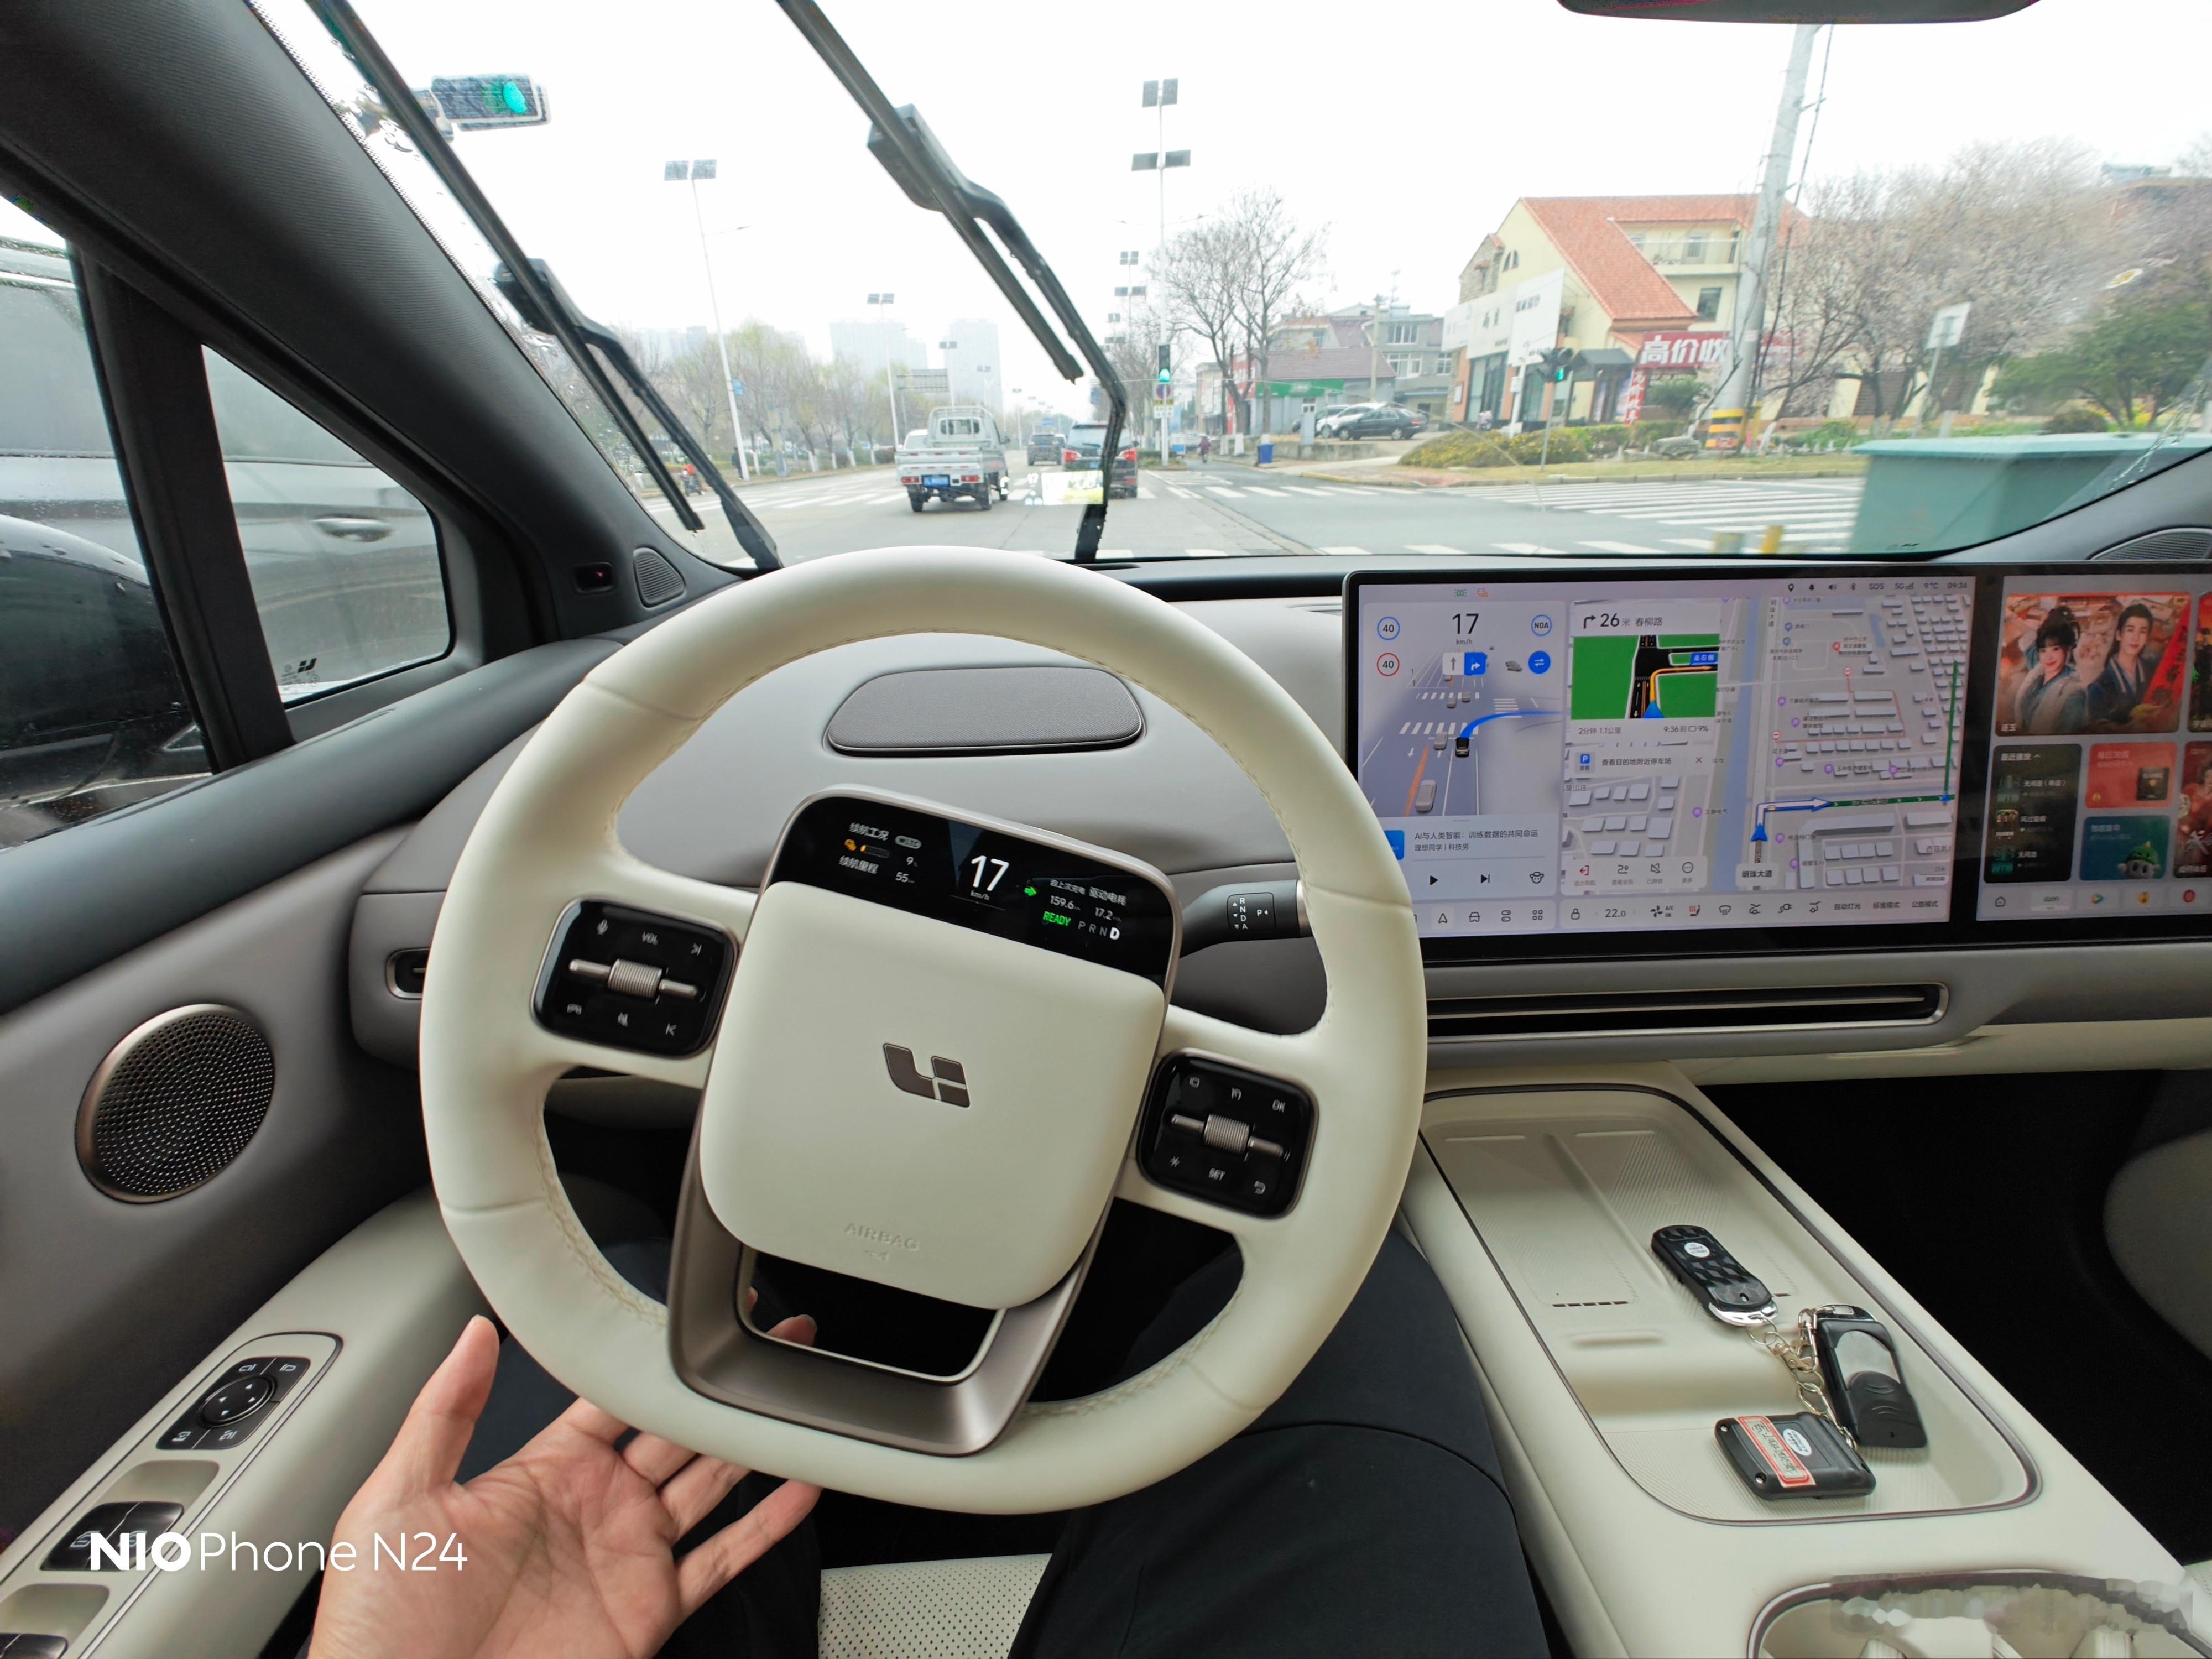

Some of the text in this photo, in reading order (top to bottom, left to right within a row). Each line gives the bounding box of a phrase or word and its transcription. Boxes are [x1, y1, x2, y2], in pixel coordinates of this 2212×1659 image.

[1452, 613, 1479, 635] 17
[1600, 613, 1663, 627] 26 米 春柳路
[1383, 660, 1395, 669] 40
[1601, 757, 1672, 766] 查看目的地附近停车场
[838, 855, 879, 874] 续航里程
[971, 855, 1009, 891] 17
[1742, 870, 1773, 878] 明珠大道
[970, 890, 990, 900] km/h
[1042, 911, 1072, 926] READY
[1605, 908, 1626, 918] 22.0
[1078, 920, 1120, 940] P R N D
[641, 931, 659, 946] VOL
[1272, 1099, 1286, 1113] OK
[1208, 1167, 1226, 1181] SET
[844, 1222, 920, 1251] AIRBAG
